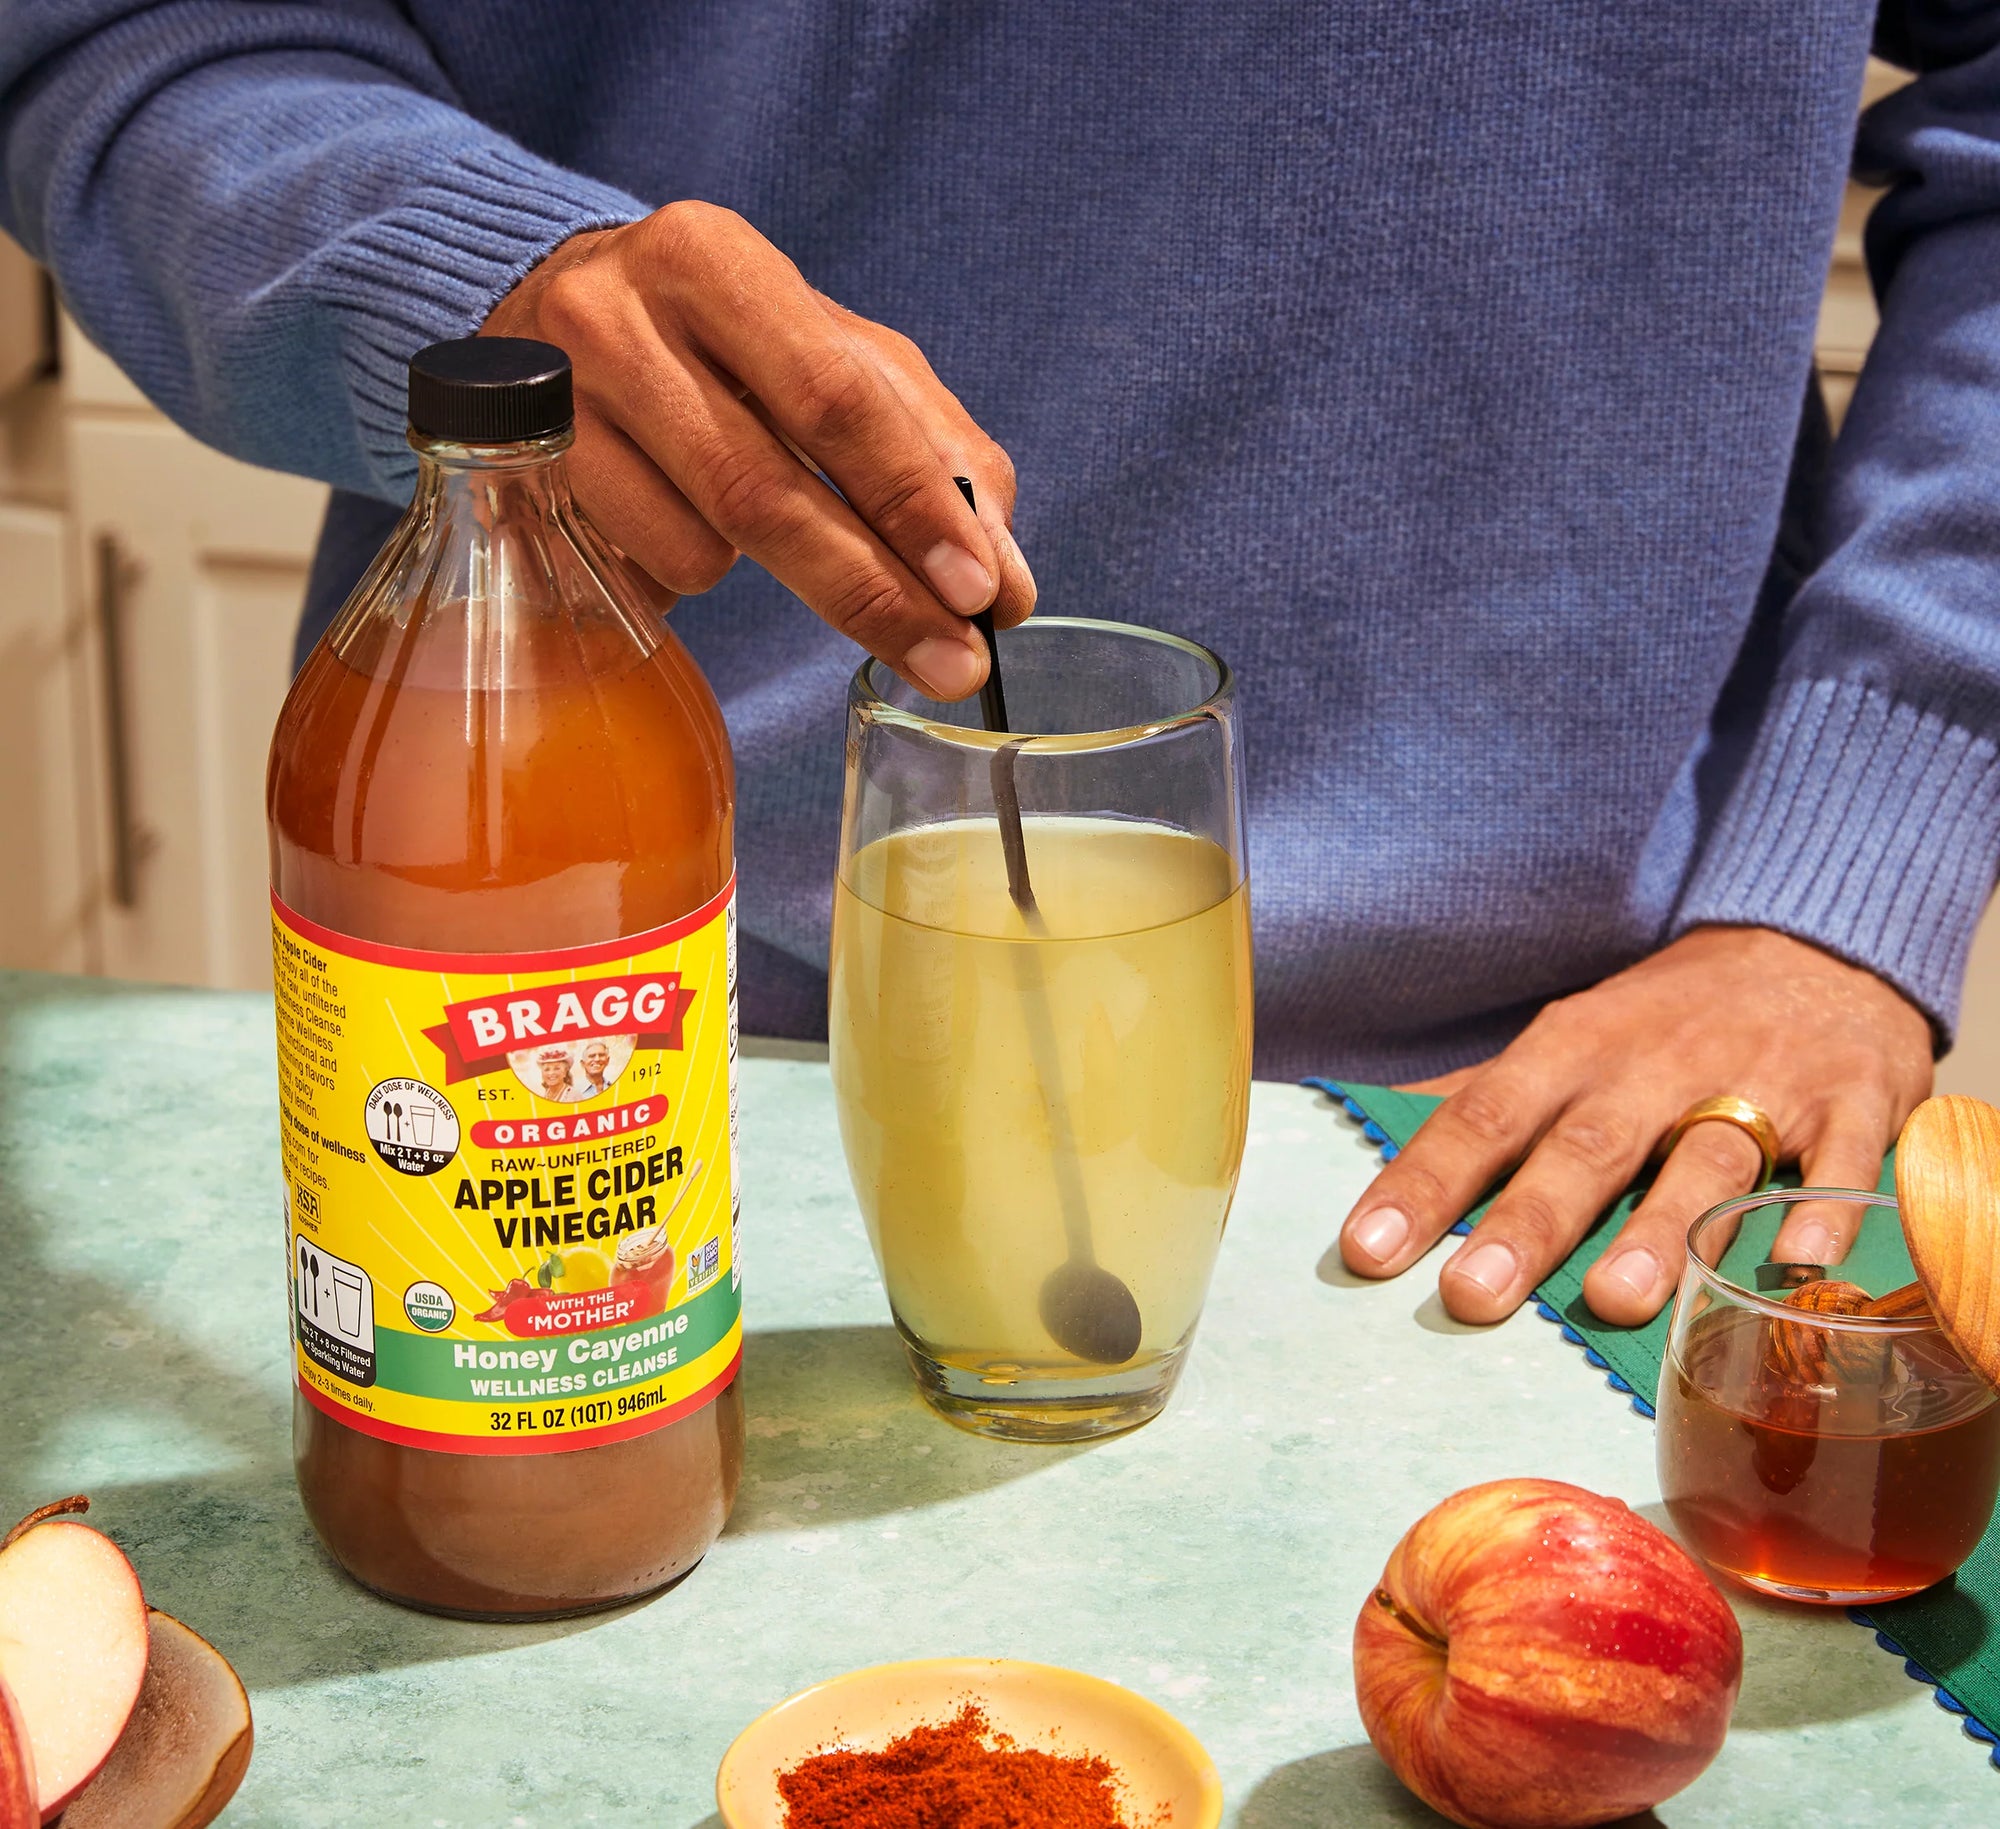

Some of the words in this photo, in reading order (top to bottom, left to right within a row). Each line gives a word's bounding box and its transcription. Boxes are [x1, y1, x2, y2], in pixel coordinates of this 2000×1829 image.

[283, 934, 300, 960] Apple
[303, 949, 327, 973] Cider
[300, 968, 309, 984] all
[311, 975, 319, 989] of
[322, 978, 338, 997] the
[303, 989, 346, 1019] unfiltered
[467, 982, 666, 1047] BRAGG
[296, 1019, 334, 1052] Wellness
[306, 1007, 345, 1038] Cleanse.
[306, 1062, 335, 1091] flavors
[320, 1055, 337, 1073] and
[295, 1076, 314, 1100] spicy
[477, 1089, 515, 1101] EST.
[632, 1063, 661, 1082] 1912
[295, 1091, 320, 1121] lemon.
[369, 1088, 384, 1110] DAILY
[382, 1081, 402, 1094] DOSE
[404, 1081, 415, 1091] OF
[417, 1085, 455, 1121] WELLNESS
[494, 1103, 651, 1144] ORGANIC
[294, 1116, 309, 1138] dose
[311, 1130, 319, 1144] of
[321, 1136, 366, 1164] wellness
[380, 1143, 396, 1156] Mix
[397, 1147, 404, 1157] 2
[406, 1149, 412, 1159] T
[423, 1151, 430, 1162] 8
[432, 1154, 445, 1163] oz
[307, 1147, 319, 1165] for
[398, 1158, 425, 1172] Water
[300, 1163, 330, 1190] recipes.
[454, 1174, 576, 1210] APPLE
[587, 1145, 684, 1201] CIDER
[298, 1213, 319, 1234] KOSHER
[493, 1195, 657, 1248] VINEGAR
[411, 1306, 448, 1320] ORGANIC
[415, 1292, 443, 1306] USDA
[546, 1299, 585, 1311] WITH
[587, 1291, 615, 1303] THE
[325, 1339, 330, 1349] 8
[331, 1343, 340, 1354] oz
[341, 1346, 371, 1367] Filtered
[454, 1344, 557, 1373] Honey
[568, 1314, 689, 1363] Cayenne
[311, 1342, 341, 1370] Sparkling
[342, 1361, 365, 1379] Water
[470, 1372, 587, 1397] WELLNESS
[592, 1347, 677, 1387] CLEANSE
[303, 1361, 317, 1384] Enjoy
[318, 1374, 330, 1390] 2-3
[331, 1383, 351, 1402] times
[353, 1394, 376, 1413] daily.
[490, 1412, 511, 1430] 32
[517, 1411, 537, 1430] FL
[543, 1408, 565, 1428] OZ
[570, 1400, 612, 1427] (1QT)
[617, 1385, 667, 1416] 946mL
